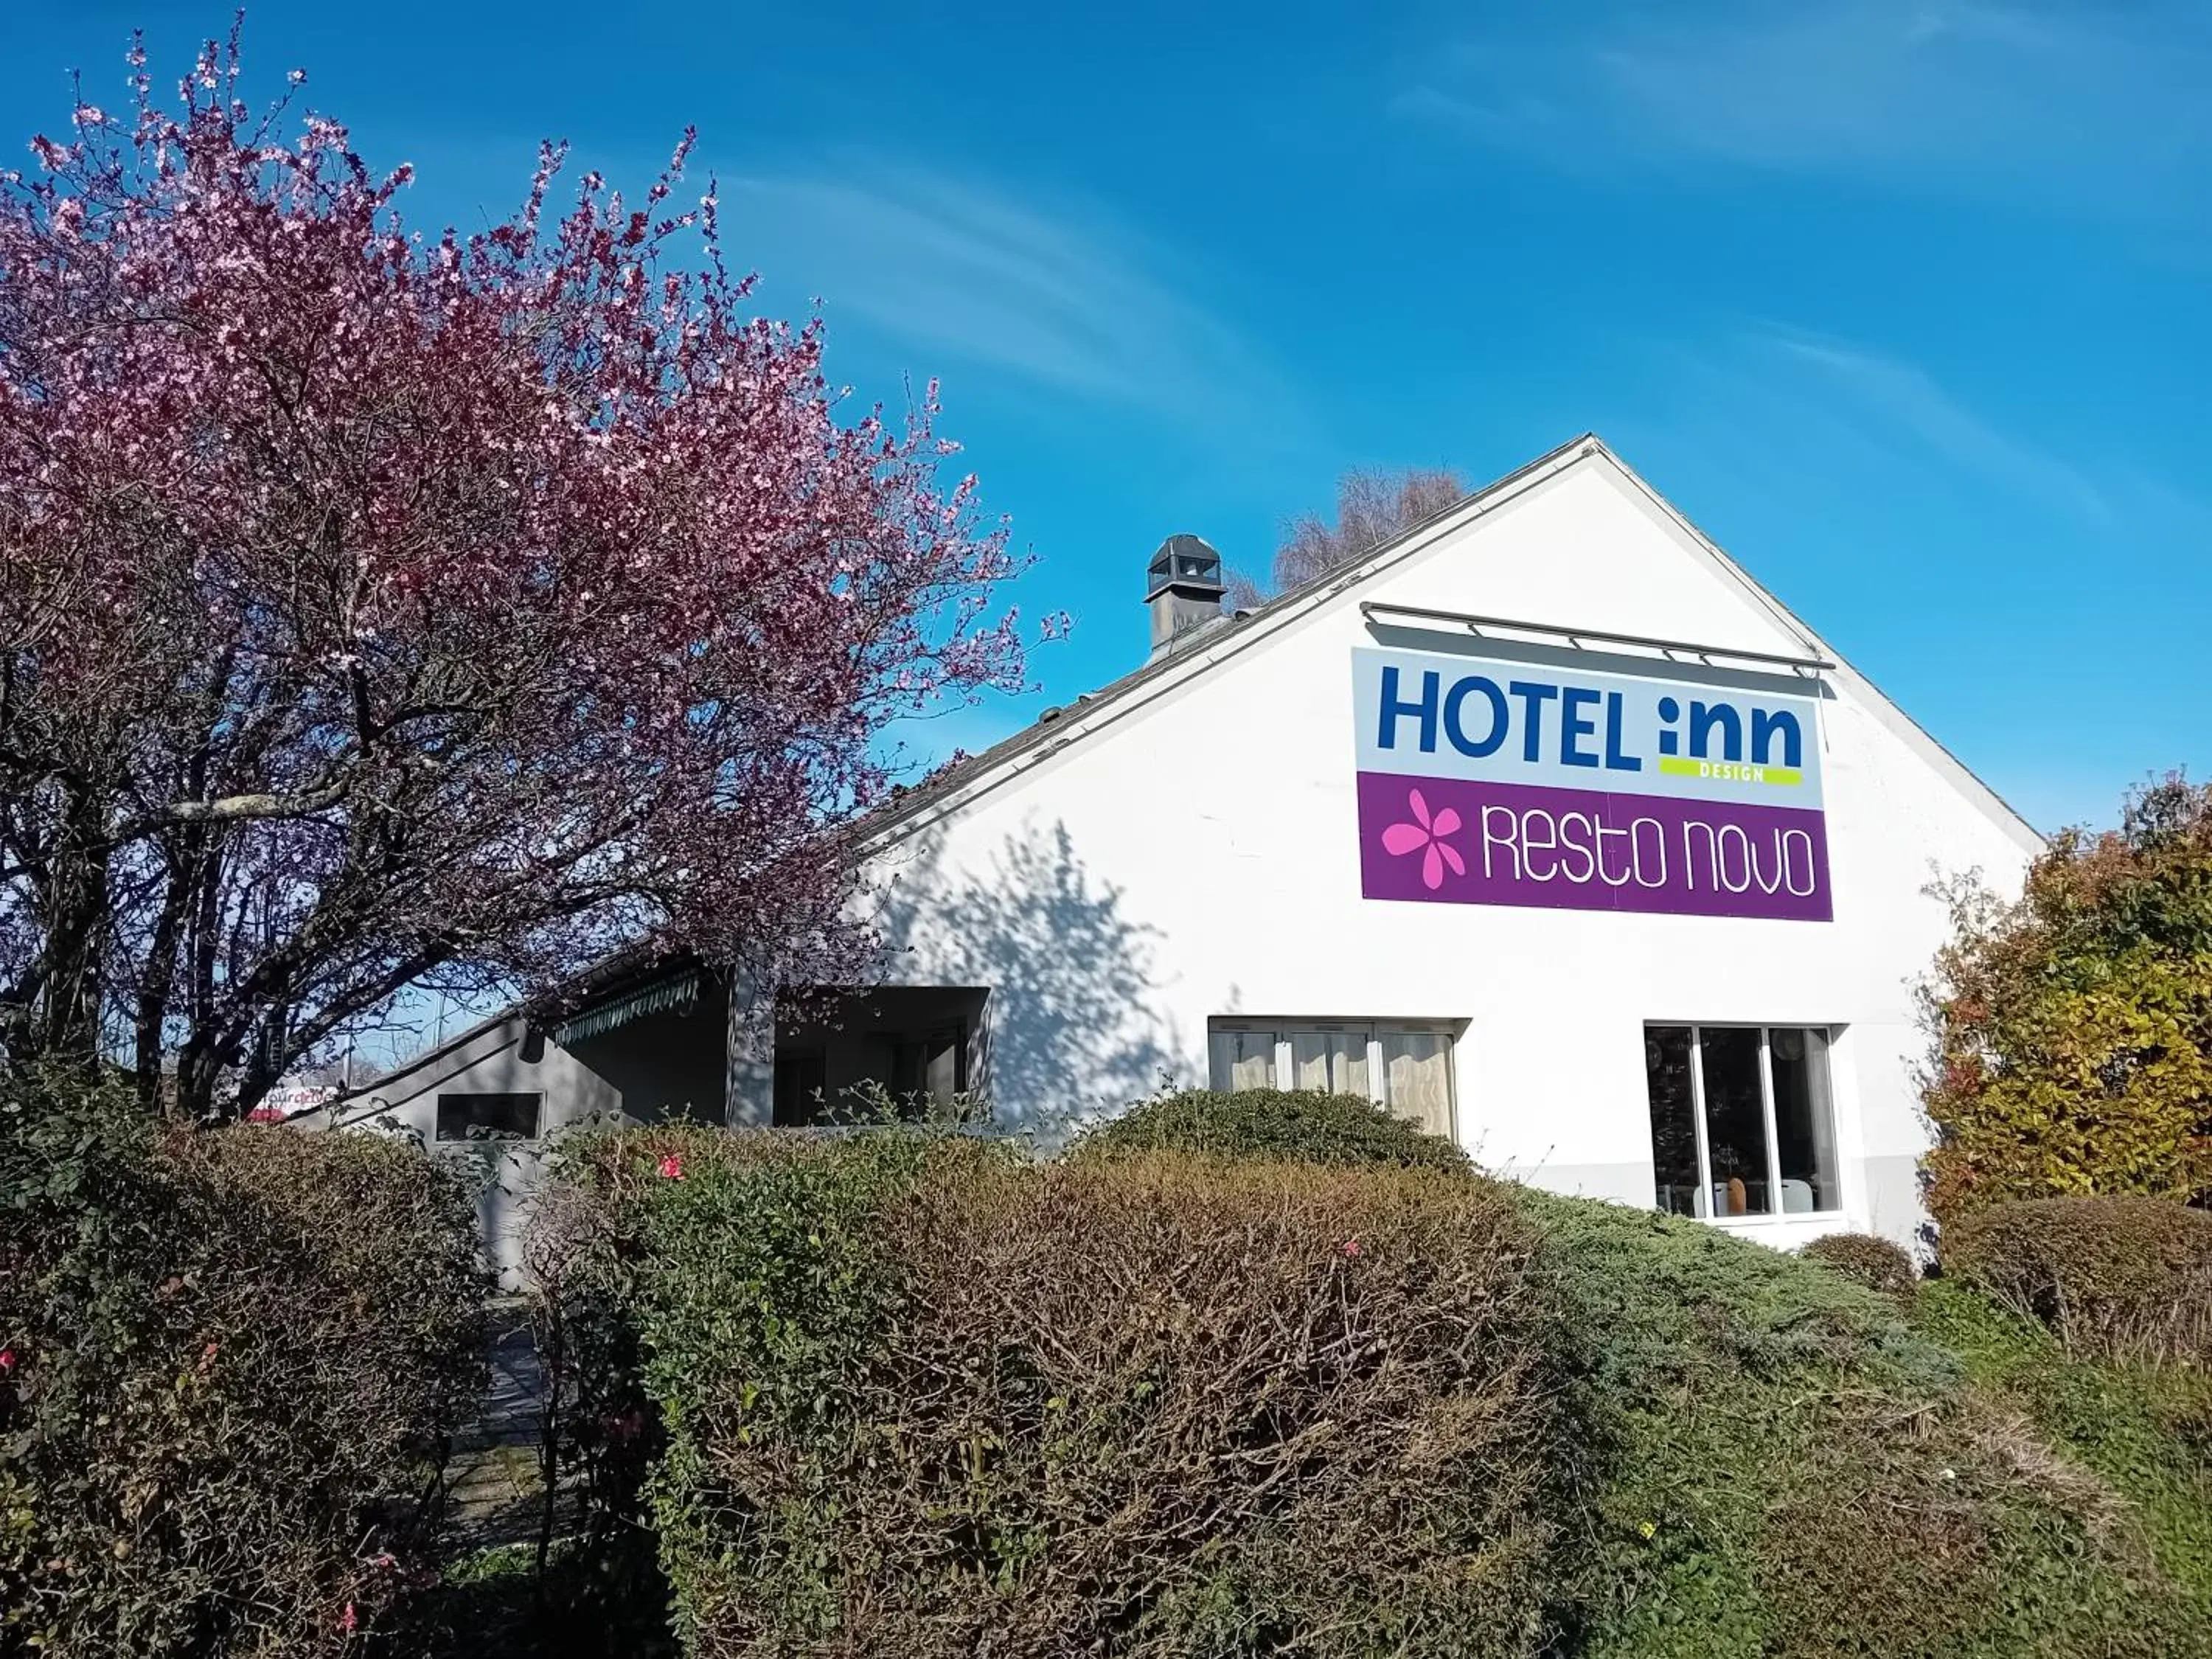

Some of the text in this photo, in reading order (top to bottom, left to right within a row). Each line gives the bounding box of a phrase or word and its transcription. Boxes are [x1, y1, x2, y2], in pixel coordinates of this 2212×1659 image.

[1377, 666, 1801, 772] HOTEL inn
[1699, 761, 1764, 782] DESIGN
[1481, 805, 1815, 897] Resto novo
